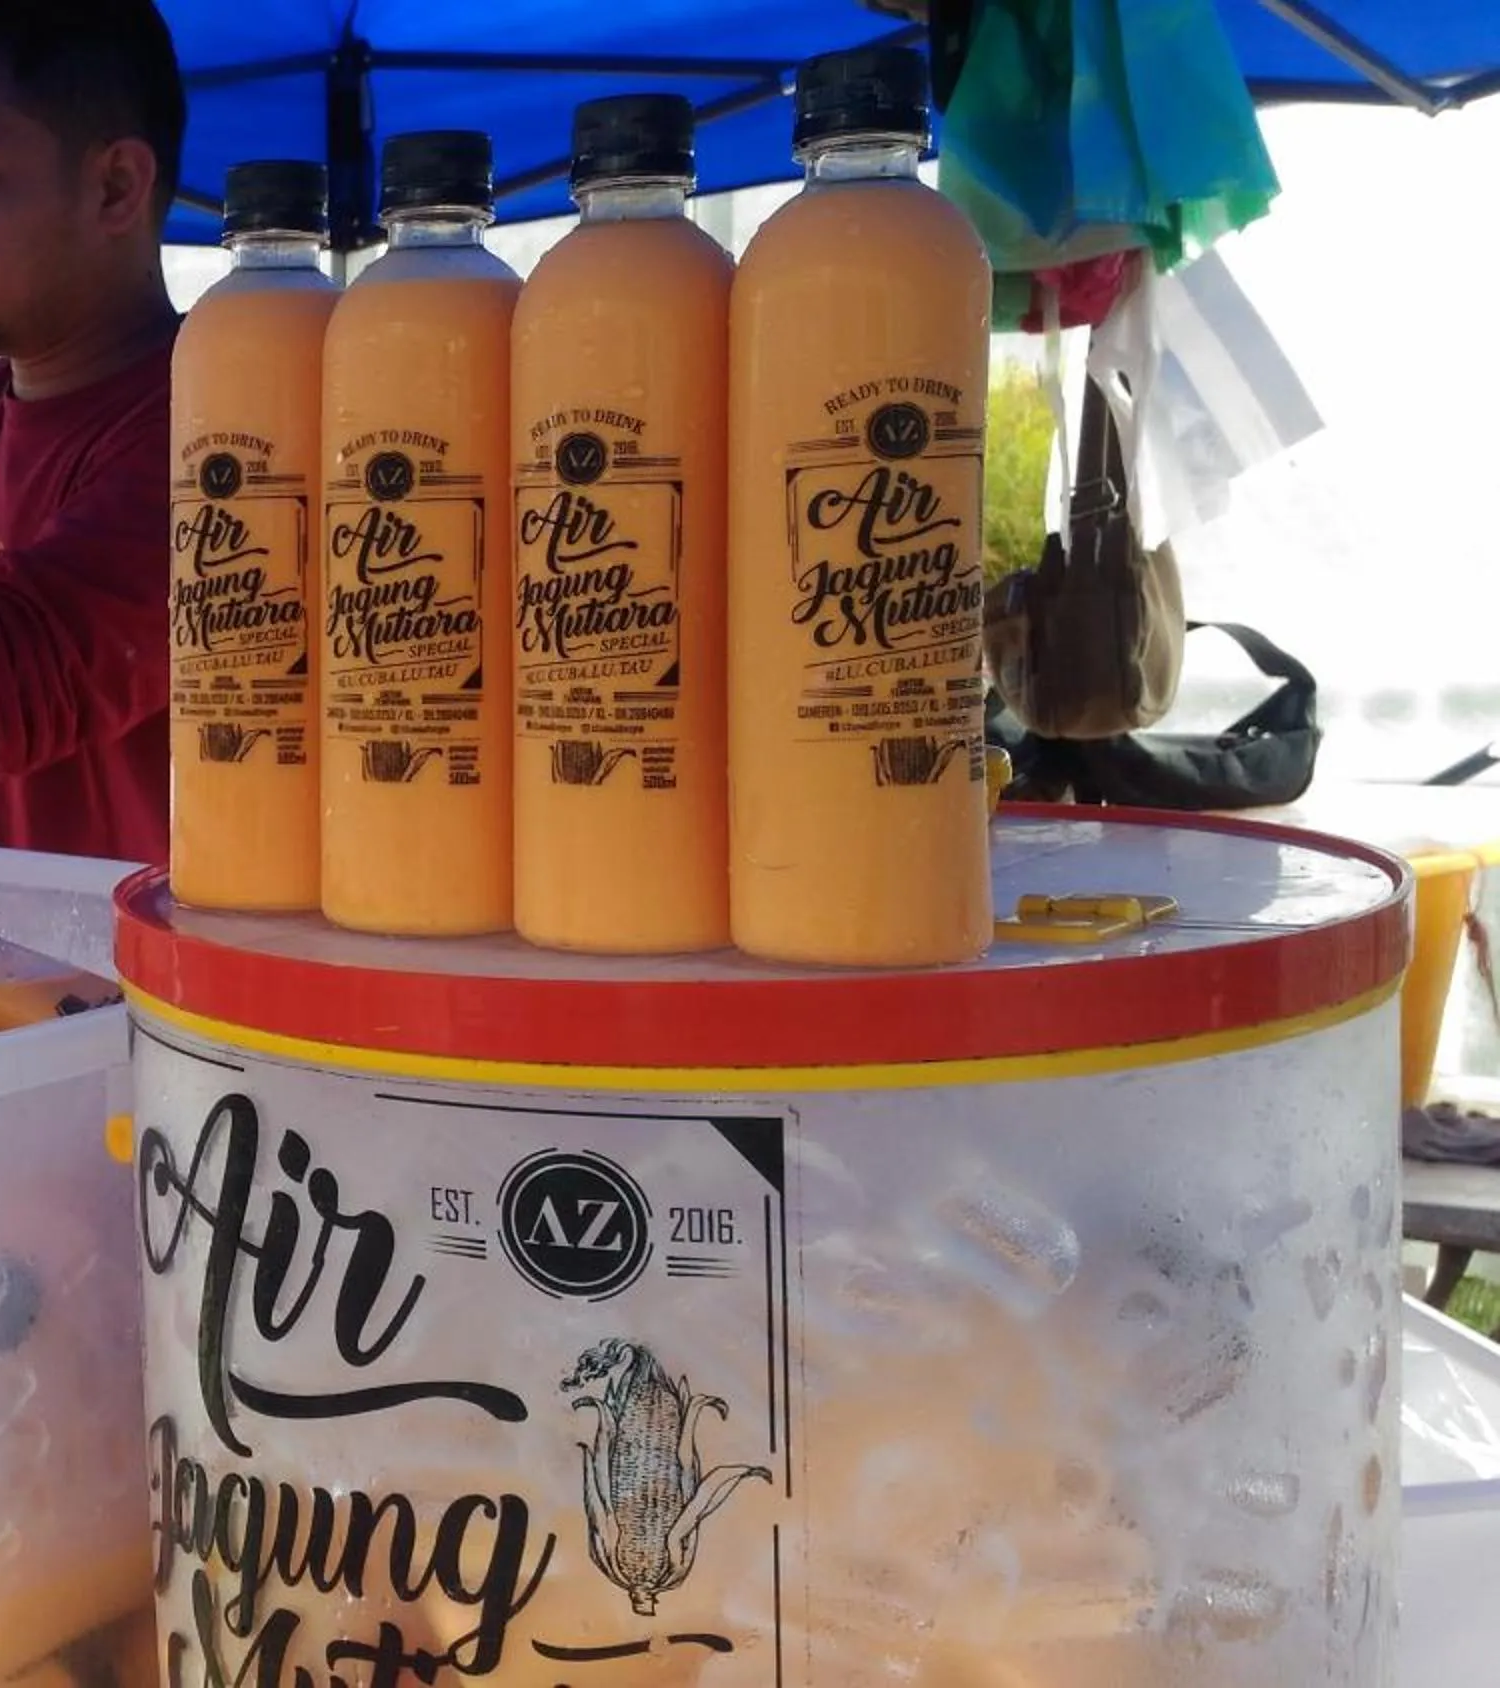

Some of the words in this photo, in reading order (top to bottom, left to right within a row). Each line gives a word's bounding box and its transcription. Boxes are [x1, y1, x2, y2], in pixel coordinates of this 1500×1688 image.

[593, 409, 647, 435] DRINK
[824, 379, 883, 415] READY
[885, 378, 909, 395] TO
[912, 377, 963, 404] DRINK
[380, 430, 399, 444] TO
[401, 430, 450, 456] DRINK
[175, 504, 250, 578] Air
[522, 491, 614, 574] Air
[808, 467, 941, 556] Air
[332, 505, 423, 585] Air
[173, 566, 266, 625] Jagung
[327, 573, 438, 636] Jagung
[517, 562, 635, 628] Jagung
[792, 541, 960, 624] Jagung
[175, 596, 305, 652] Mutiara
[333, 605, 479, 664] Mutiara
[522, 601, 679, 658] Mutiara
[430, 1186, 482, 1227] EST.
[523, 1199, 624, 1253] AZ
[669, 1207, 744, 1246] 2016.
[141, 1093, 426, 1458] Air
[148, 1415, 557, 1676] Jagung
